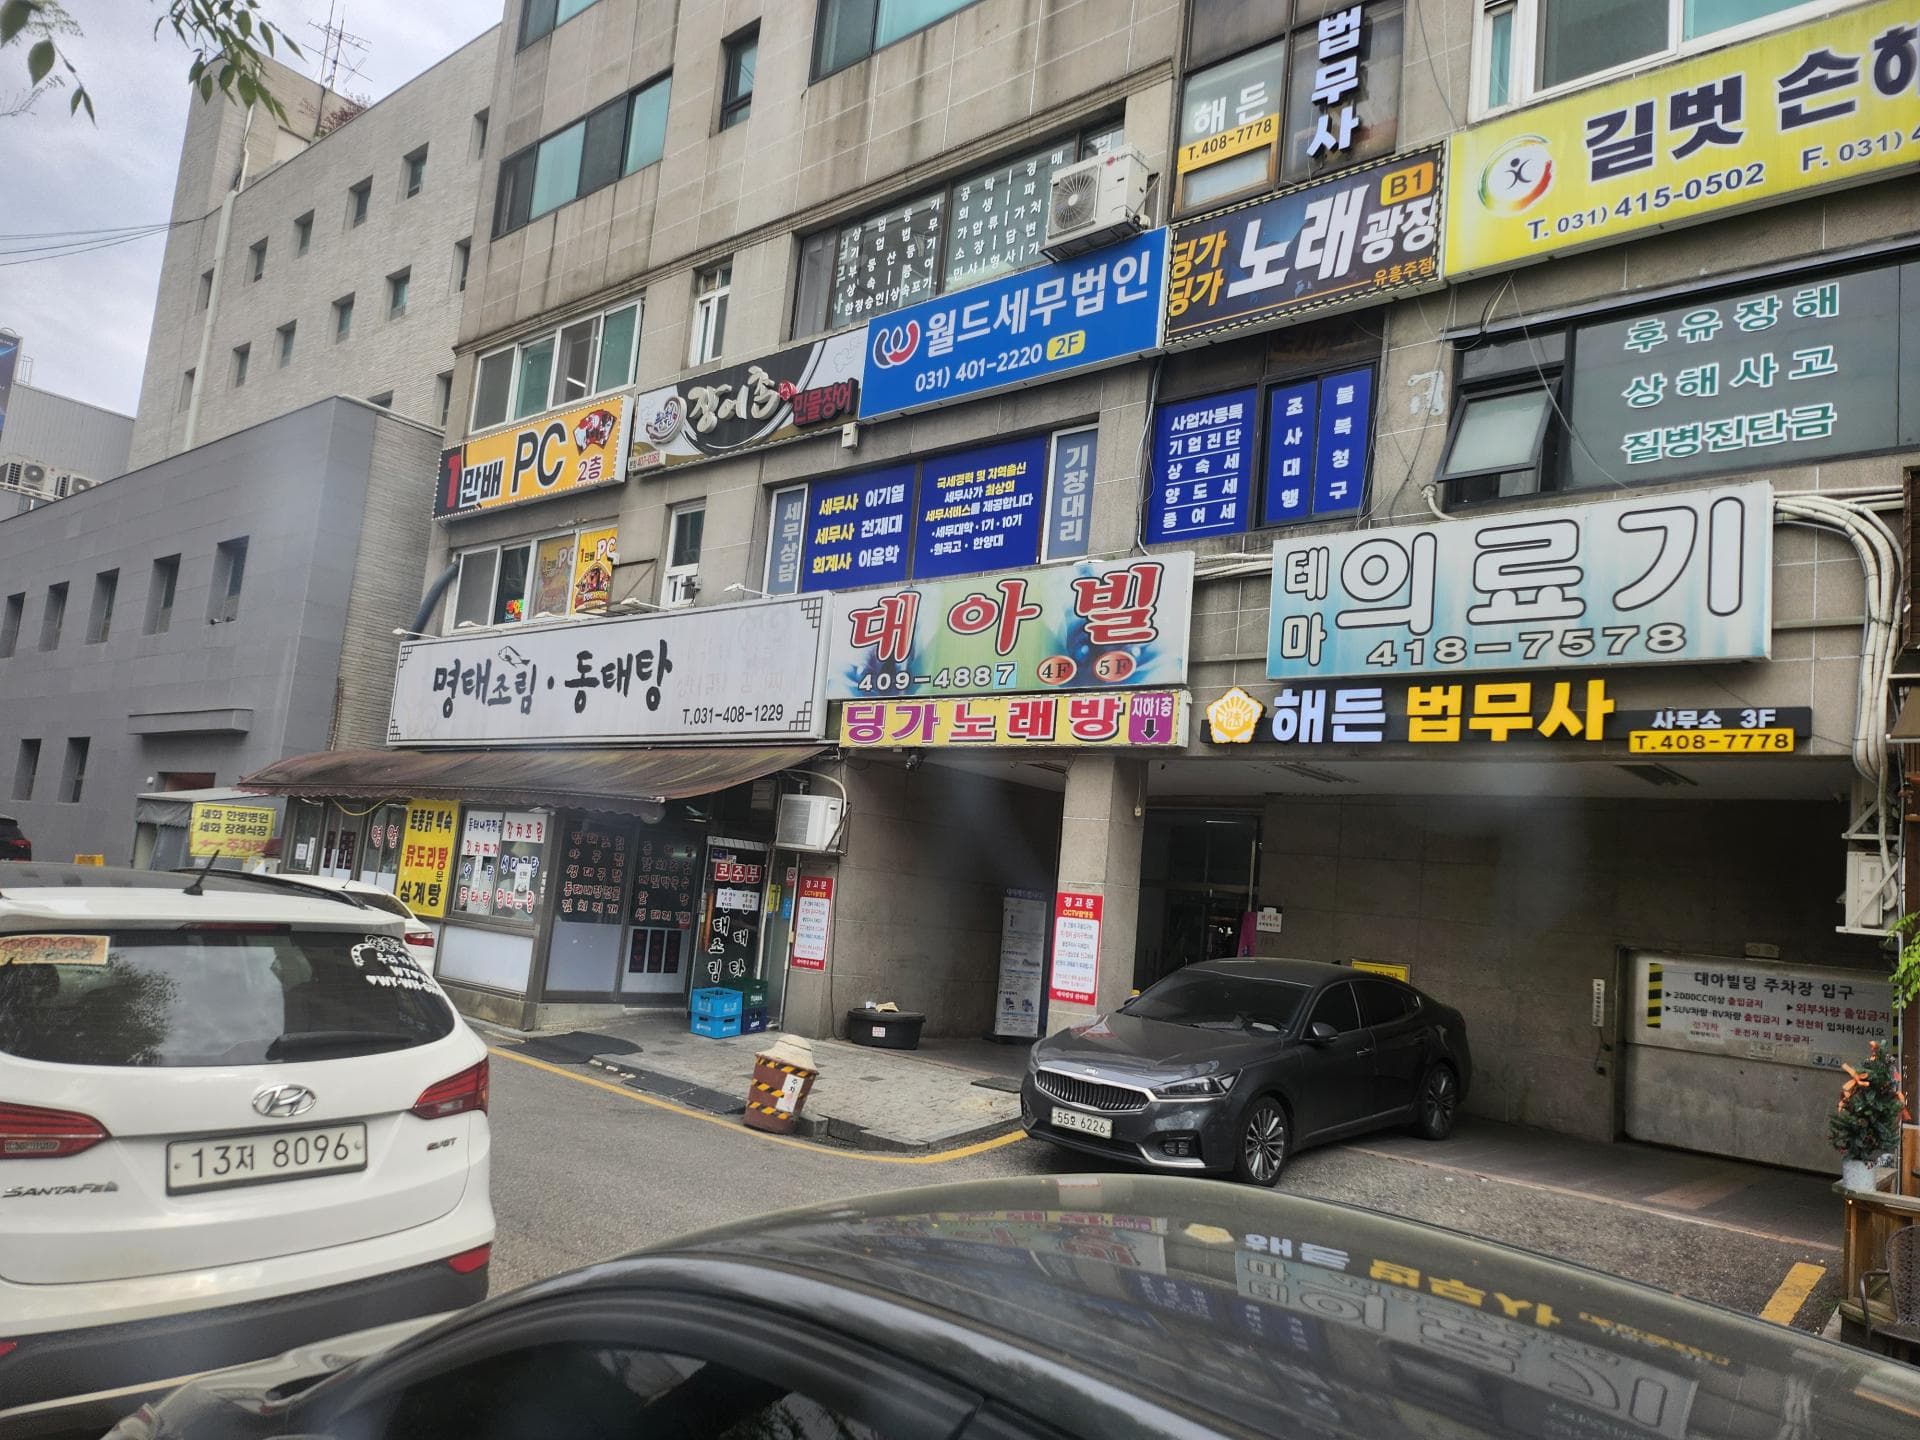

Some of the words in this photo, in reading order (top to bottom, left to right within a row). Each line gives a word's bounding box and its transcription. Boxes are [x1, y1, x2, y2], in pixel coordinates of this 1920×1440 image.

[1306, 5, 1362, 158] 법무사
[1193, 81, 1269, 135] 해든
[1188, 118, 1272, 161] T.408-7778
[1586, 73, 1744, 182] 길벗
[960, 177, 996, 202] 공탁
[1026, 150, 1063, 177] 경매
[1389, 168, 1424, 199] B1
[958, 197, 994, 220] 회생
[1557, 208, 1607, 233] 031)
[1614, 163, 1764, 218] 415-0502
[957, 215, 998, 239] 가압류
[848, 236, 937, 278] 부동산등기
[954, 239, 985, 260] 소장
[1173, 230, 1227, 278] 딩가
[1374, 257, 1434, 286] 유흥주점
[925, 250, 1150, 358] 월드세무법인
[1170, 268, 1224, 317] 딩가
[1624, 281, 1841, 354] 후유장해
[915, 373, 950, 393] 031)
[955, 344, 1043, 382] 401-2220
[1055, 339, 1080, 357] 2F
[1621, 344, 1839, 410] 상해사고
[1171, 403, 1243, 432] 사업자등록
[1169, 429, 1241, 455] 기업진단
[1621, 402, 1838, 466] 질병진단금
[444, 453, 503, 512] 1만배
[512, 421, 566, 494] PC
[1167, 453, 1240, 481] 상속세
[1281, 397, 1304, 509] 조사대행
[576, 454, 603, 485] 2층
[819, 492, 859, 516] 세무사
[865, 484, 905, 508] 이기열
[944, 486, 983, 503] 세무사가
[1058, 444, 1089, 542] 기장대리
[1165, 478, 1238, 505] 양도세
[925, 503, 980, 522] 세무서비스를
[983, 493, 1034, 514] 제공합니다
[1163, 503, 1236, 529] 증여세
[596, 536, 617, 561] PC
[778, 501, 801, 584] 세무상담
[815, 522, 855, 546] 세무사
[812, 551, 852, 574] 회계사
[1335, 496, 1746, 637] 의료기
[848, 562, 1166, 663] 대아빌
[1281, 545, 1331, 667] 테마
[1366, 621, 1689, 668] 418-7578
[433, 657, 537, 719] 명태조림
[564, 637, 673, 714] 동태탕
[858, 661, 1016, 692] 409-4887
[1041, 659, 1073, 680] 4F
[1098, 657, 1131, 678] 5F
[682, 704, 784, 727] T.031-408-1229
[1131, 697, 1173, 716] 지하1층
[1271, 685, 1389, 744] 해든
[1406, 679, 1617, 743] 법무사
[1652, 708, 1723, 731] 사무소
[1740, 708, 1778, 730] 3F
[1637, 731, 1791, 752] T.408-7778
[224, 823, 268, 837] 장례식장
[226, 810, 269, 824] 한방병원
[716, 863, 761, 883] 코주부
[400, 880, 442, 907] 삼계탕
[1063, 896, 1095, 910] 경고문
[1694, 971, 1757, 992] 대아빌딩
[1763, 976, 1814, 997] 주차장
[1821, 982, 1855, 1001] 입구
[1727, 995, 1763, 1010] 출입금지
[1796, 1002, 1840, 1019] 외부차량
[1844, 1005, 1890, 1024] 출입금지
[1743, 1012, 1780, 1027] 출입금지
[1796, 1017, 1824, 1032] 천천히
[1826, 1019, 1885, 1039] 입차하십시오
[1080, 1117, 1106, 1134] 6226
[191, 1147, 256, 1179] 13저
[272, 1132, 349, 1168] 8096
